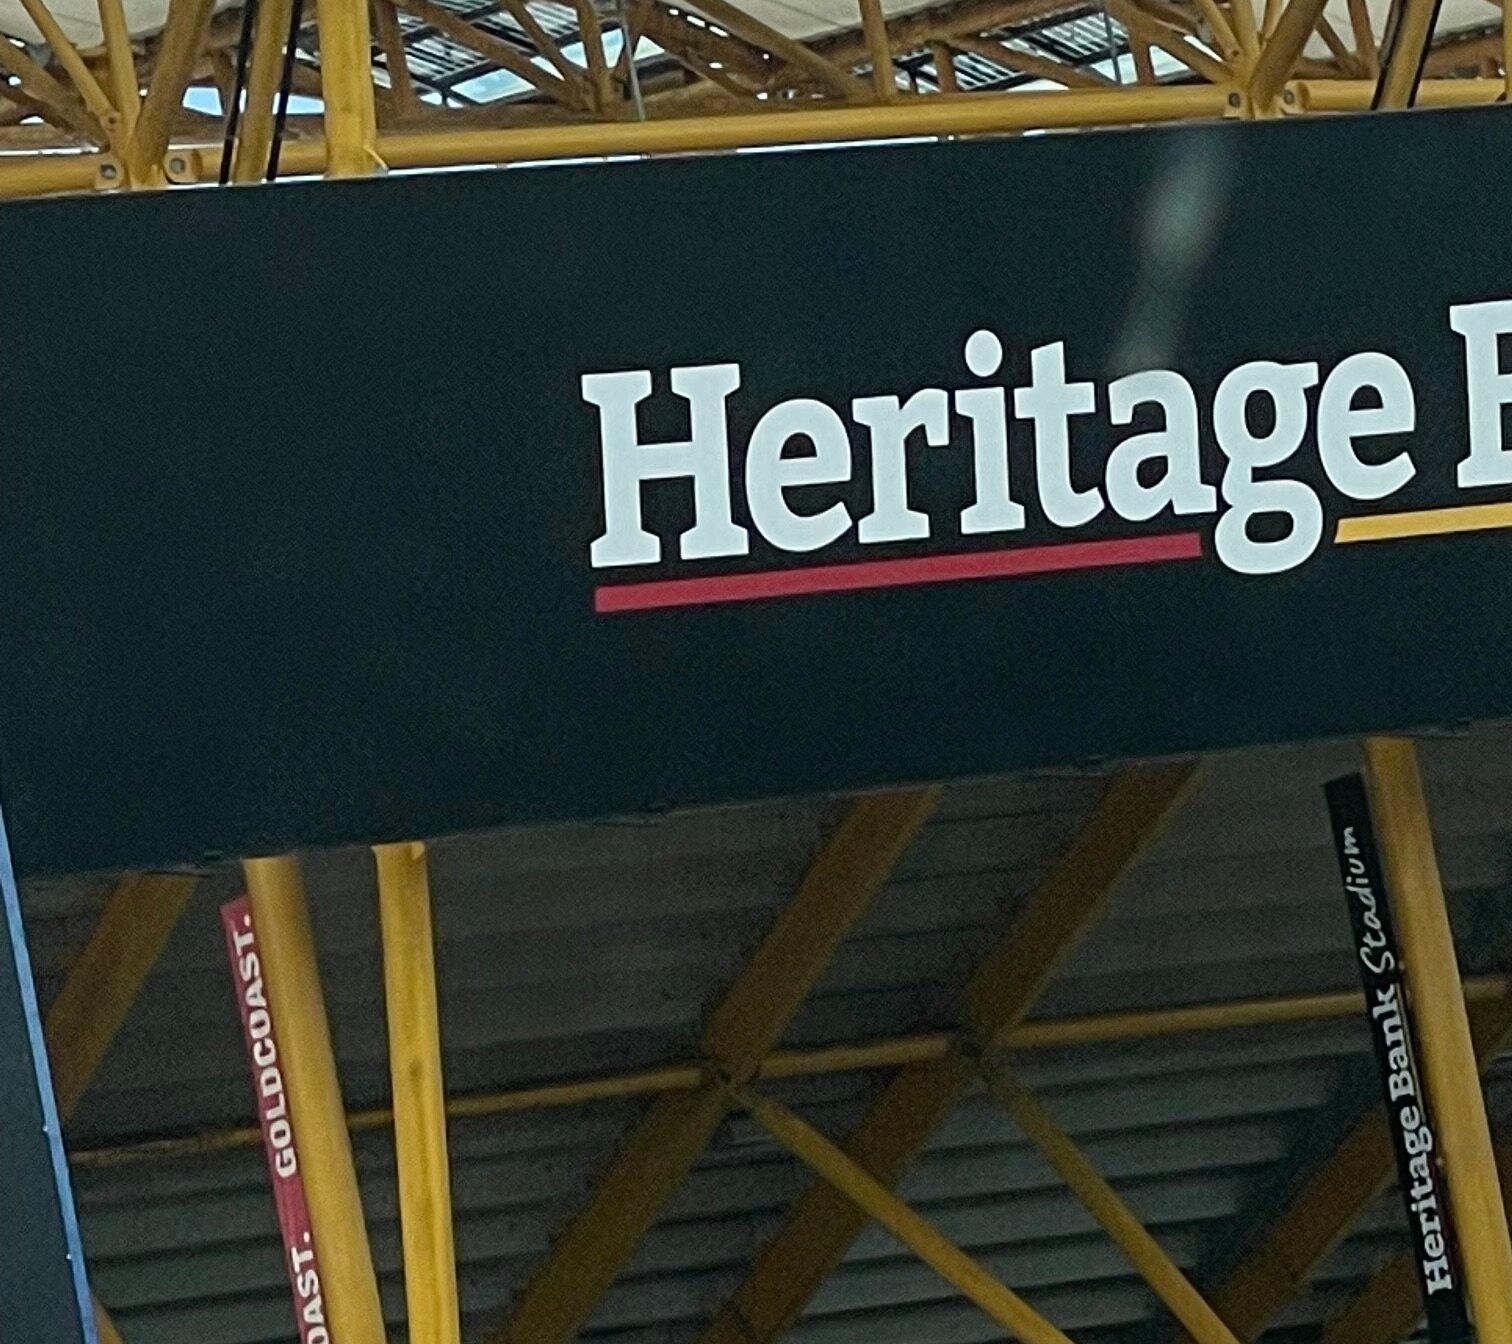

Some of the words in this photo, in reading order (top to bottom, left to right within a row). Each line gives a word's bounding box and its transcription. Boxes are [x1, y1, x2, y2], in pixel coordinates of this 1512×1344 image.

[582, 330, 1415, 573] Heritage
[1344, 826, 1396, 973] Stadium
[1371, 983, 1415, 1101] Bank
[1400, 1105, 1453, 1296] Heritage
